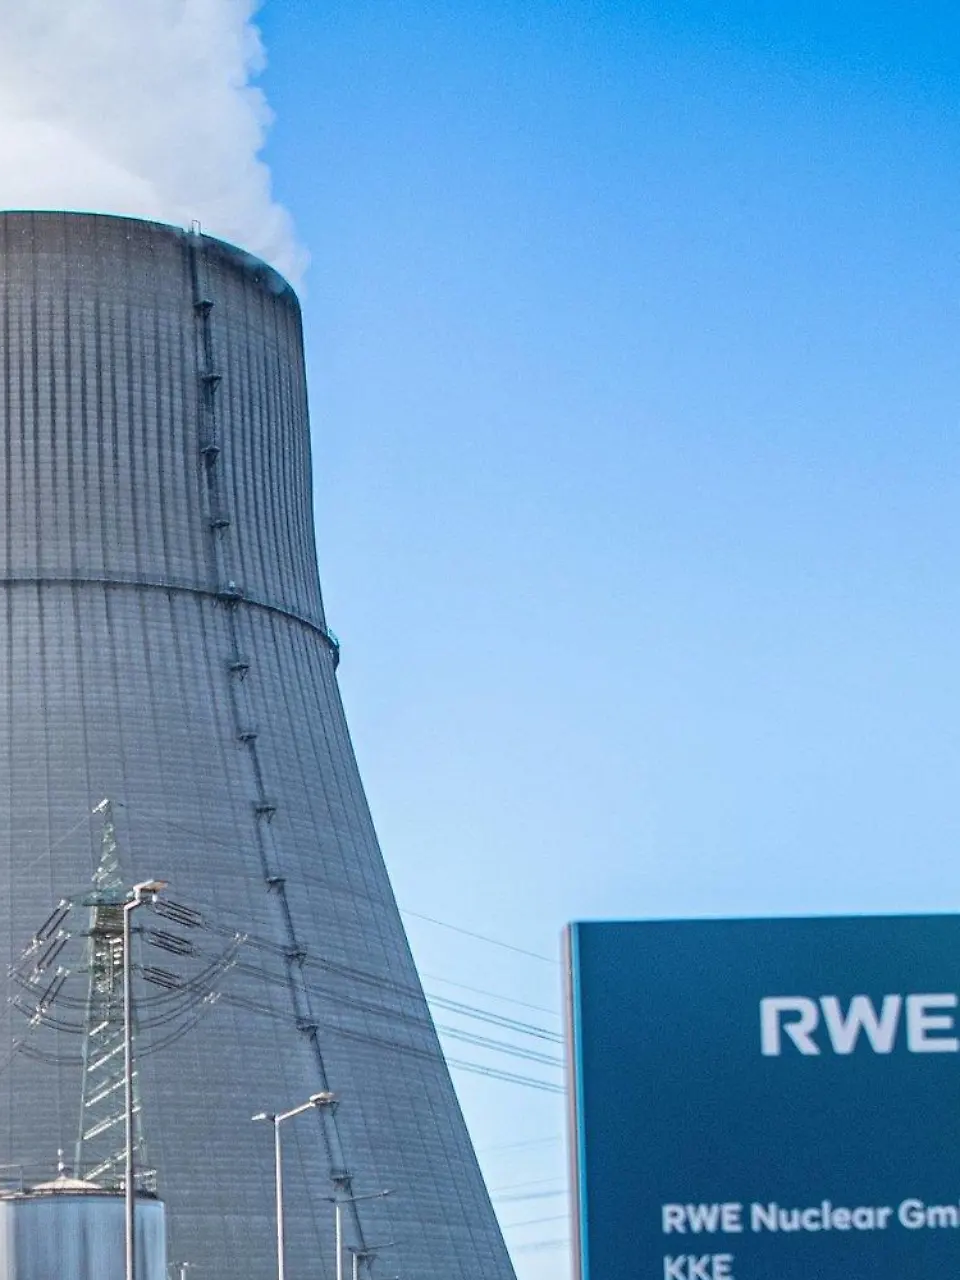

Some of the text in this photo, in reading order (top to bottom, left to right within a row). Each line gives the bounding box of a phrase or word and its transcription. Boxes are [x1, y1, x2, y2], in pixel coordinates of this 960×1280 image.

[760, 994, 959, 1056] RWE
[662, 1199, 960, 1233] RWE Nuclear Gm
